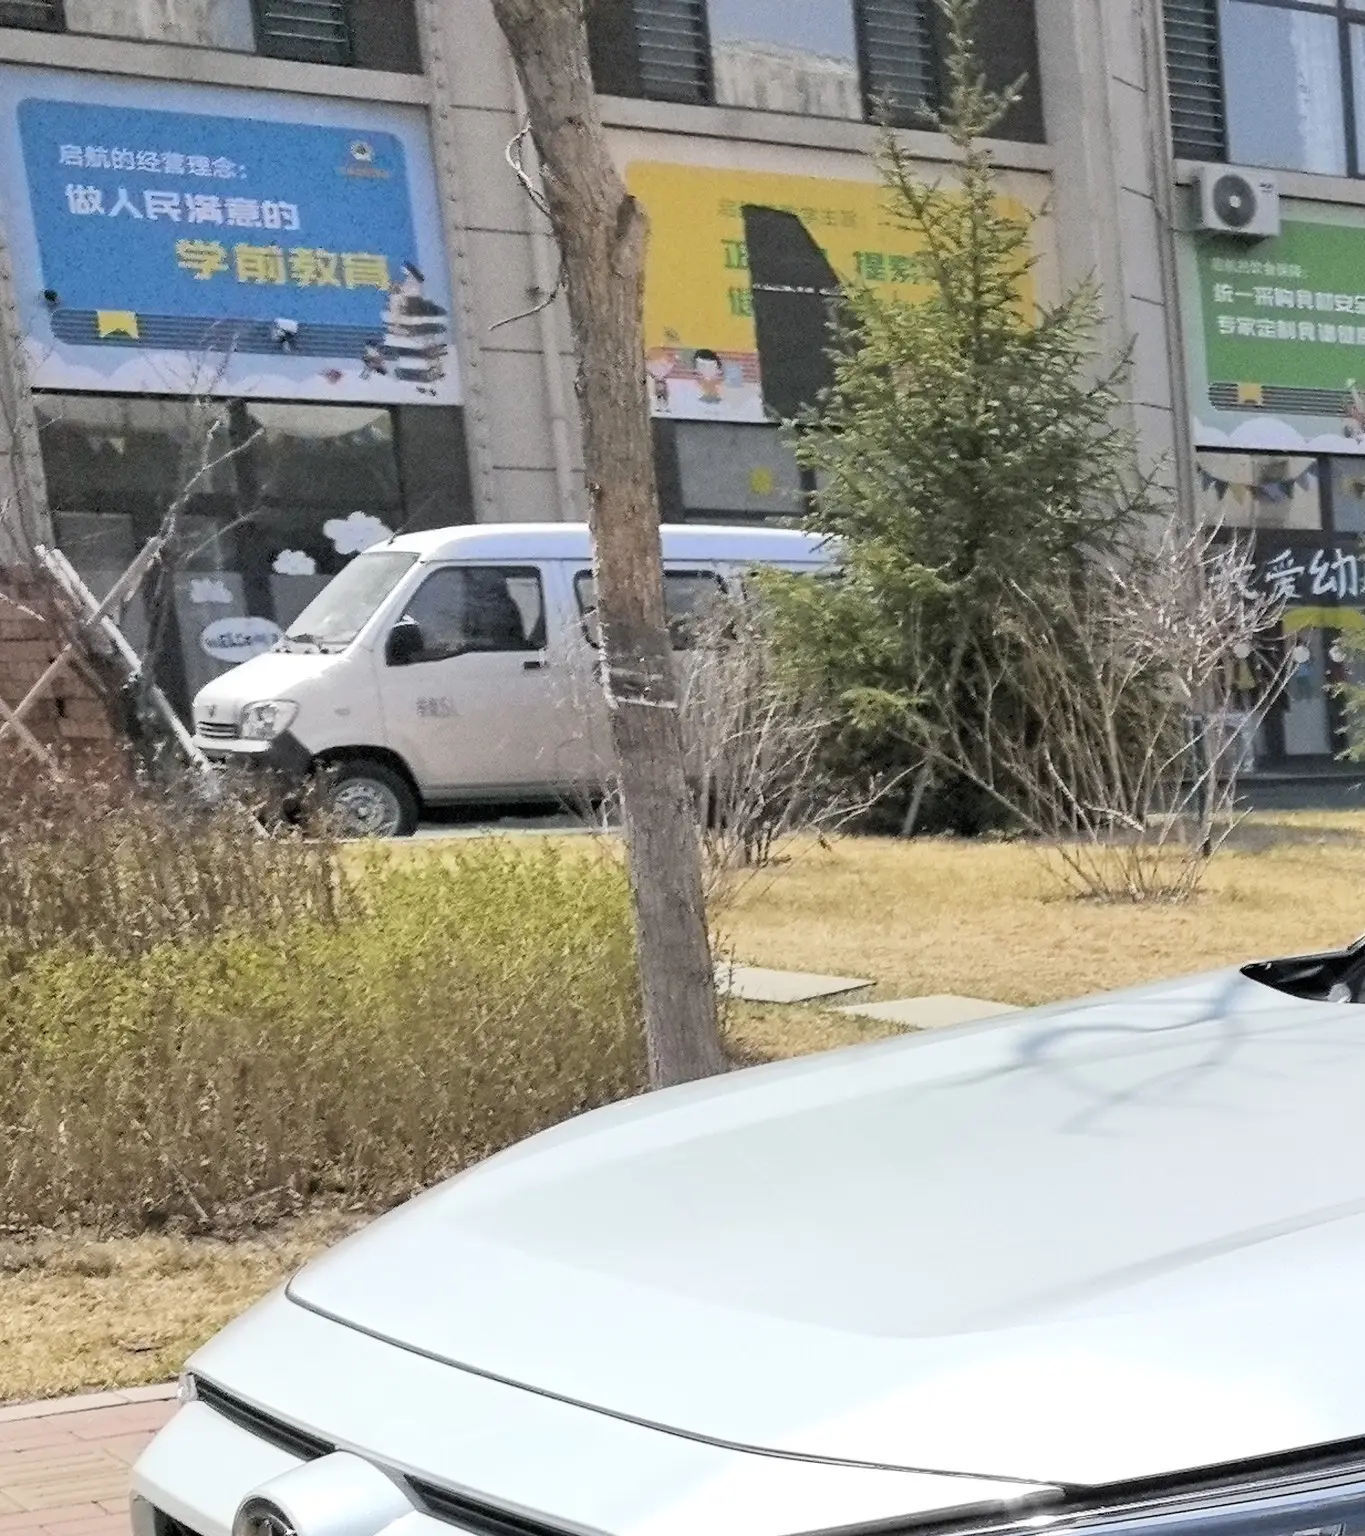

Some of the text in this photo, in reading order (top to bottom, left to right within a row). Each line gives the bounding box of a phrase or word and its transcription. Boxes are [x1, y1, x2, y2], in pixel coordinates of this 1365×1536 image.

[65, 183, 300, 231] 做人民满意的
[175, 238, 391, 291] 学前教育
